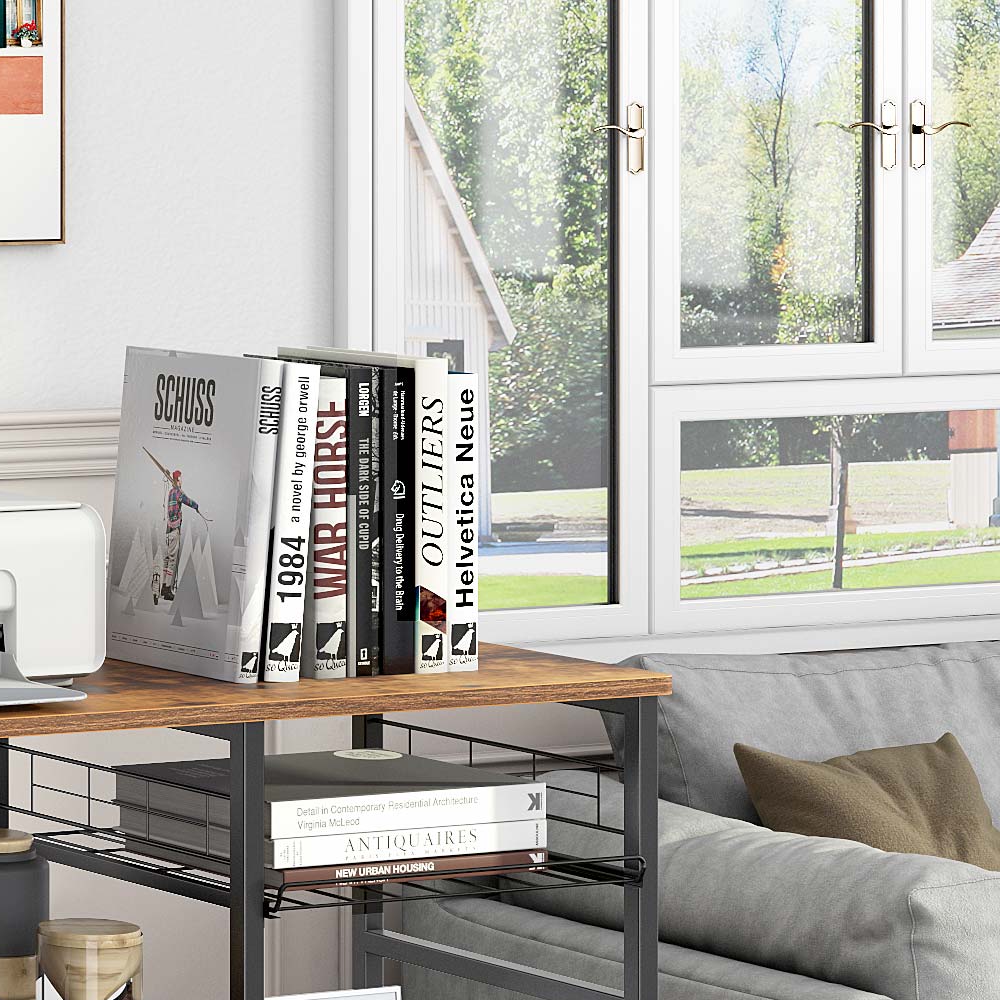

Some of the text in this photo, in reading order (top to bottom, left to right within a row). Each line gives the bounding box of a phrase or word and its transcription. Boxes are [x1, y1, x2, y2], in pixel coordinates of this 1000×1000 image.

[154, 374, 215, 427] SCHUSS
[258, 385, 282, 435] SCHUSS
[358, 382, 370, 417] LORGEN
[170, 424, 195, 433] MAGAZINE
[276, 376, 310, 603] 1984 a novel by george orwell
[313, 399, 347, 600] WAR HORSE
[358, 438, 369, 550] THE DARK SIDE OF CUPID
[421, 396, 444, 567] OUTLIERS
[455, 388, 474, 608] Helvetica Neue
[393, 513, 404, 611] Drug Delivery to the Brain
[296, 796, 479, 817] Detail in Contemporary Residential Architecture
[297, 817, 360, 831] Virginia McLeod
[344, 828, 477, 853] ANTIQUAIRES
[335, 861, 435, 879] NEW URBAN HOUSING
